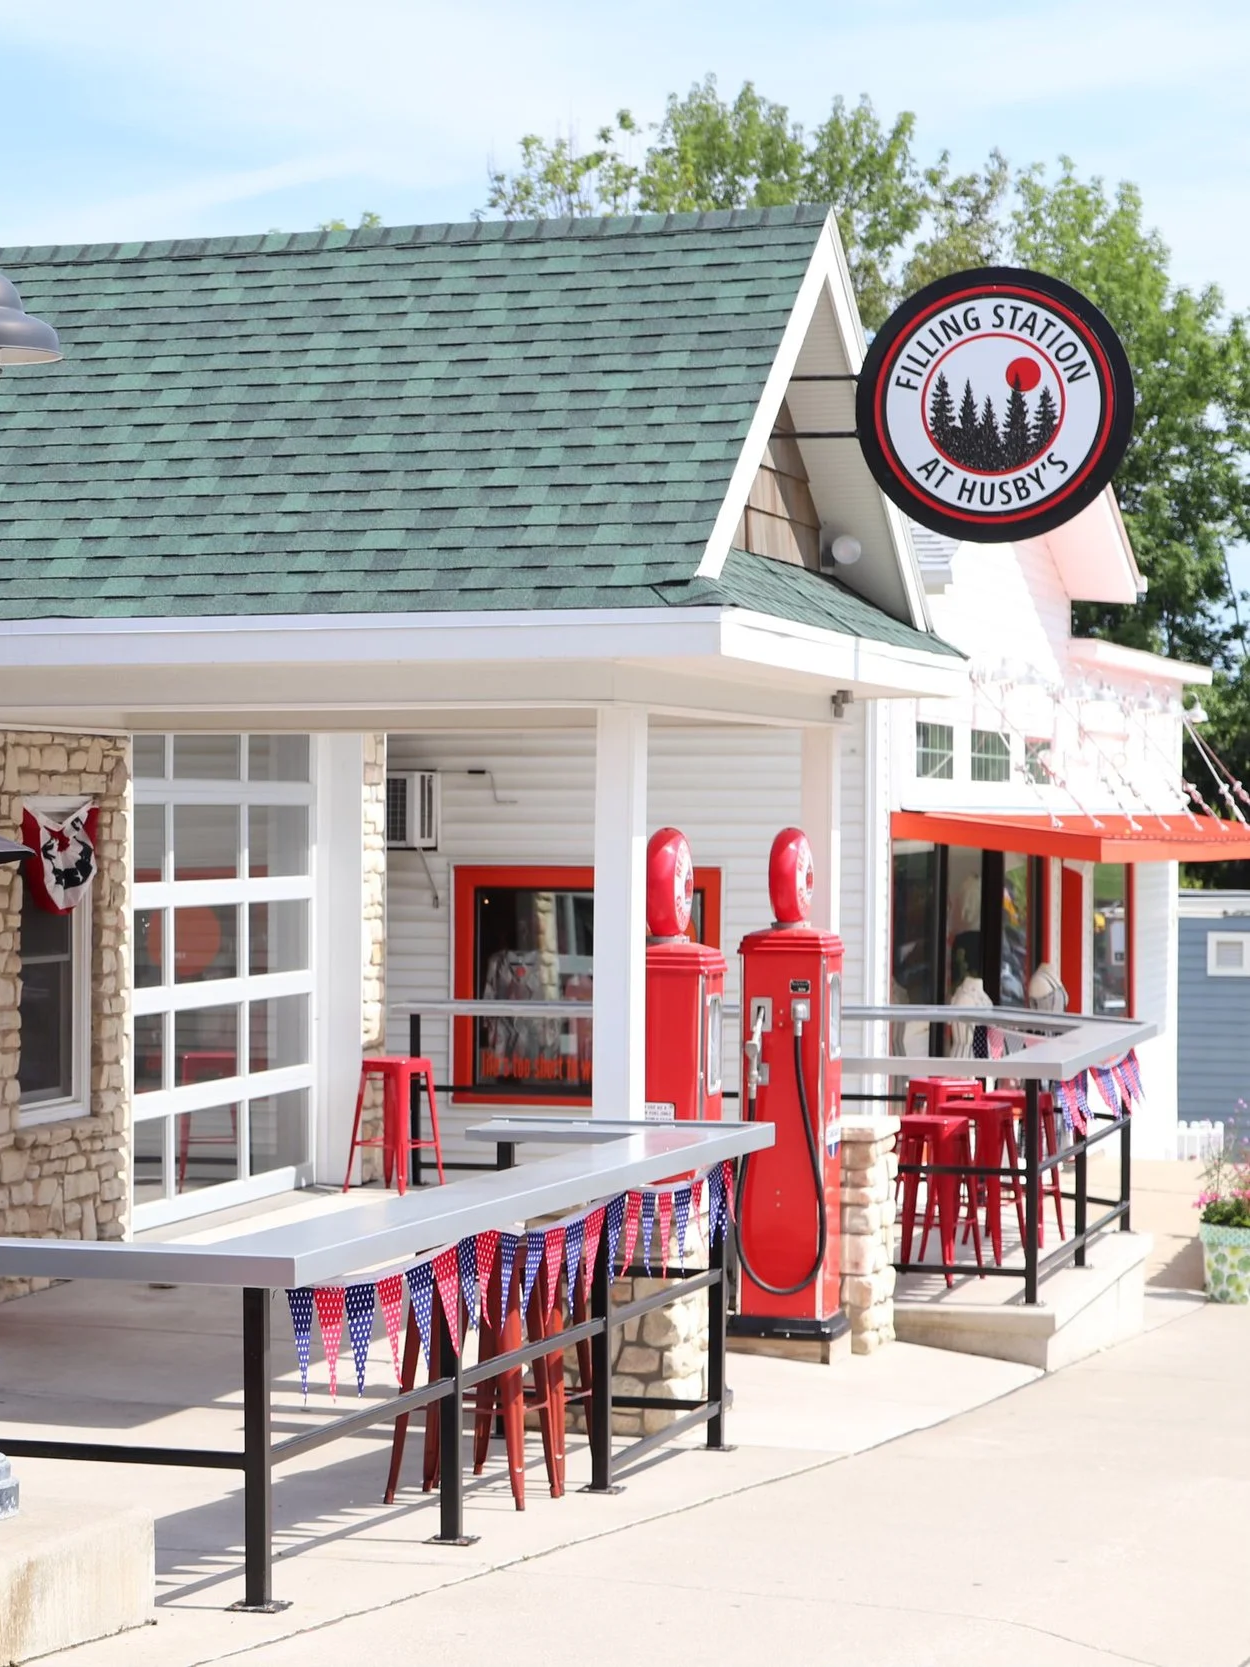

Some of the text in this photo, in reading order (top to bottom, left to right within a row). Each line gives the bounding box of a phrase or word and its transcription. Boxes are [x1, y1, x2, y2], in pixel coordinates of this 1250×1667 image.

[895, 304, 1091, 391] FILLING STATION
[917, 452, 1068, 506] AT HUSBY'S
